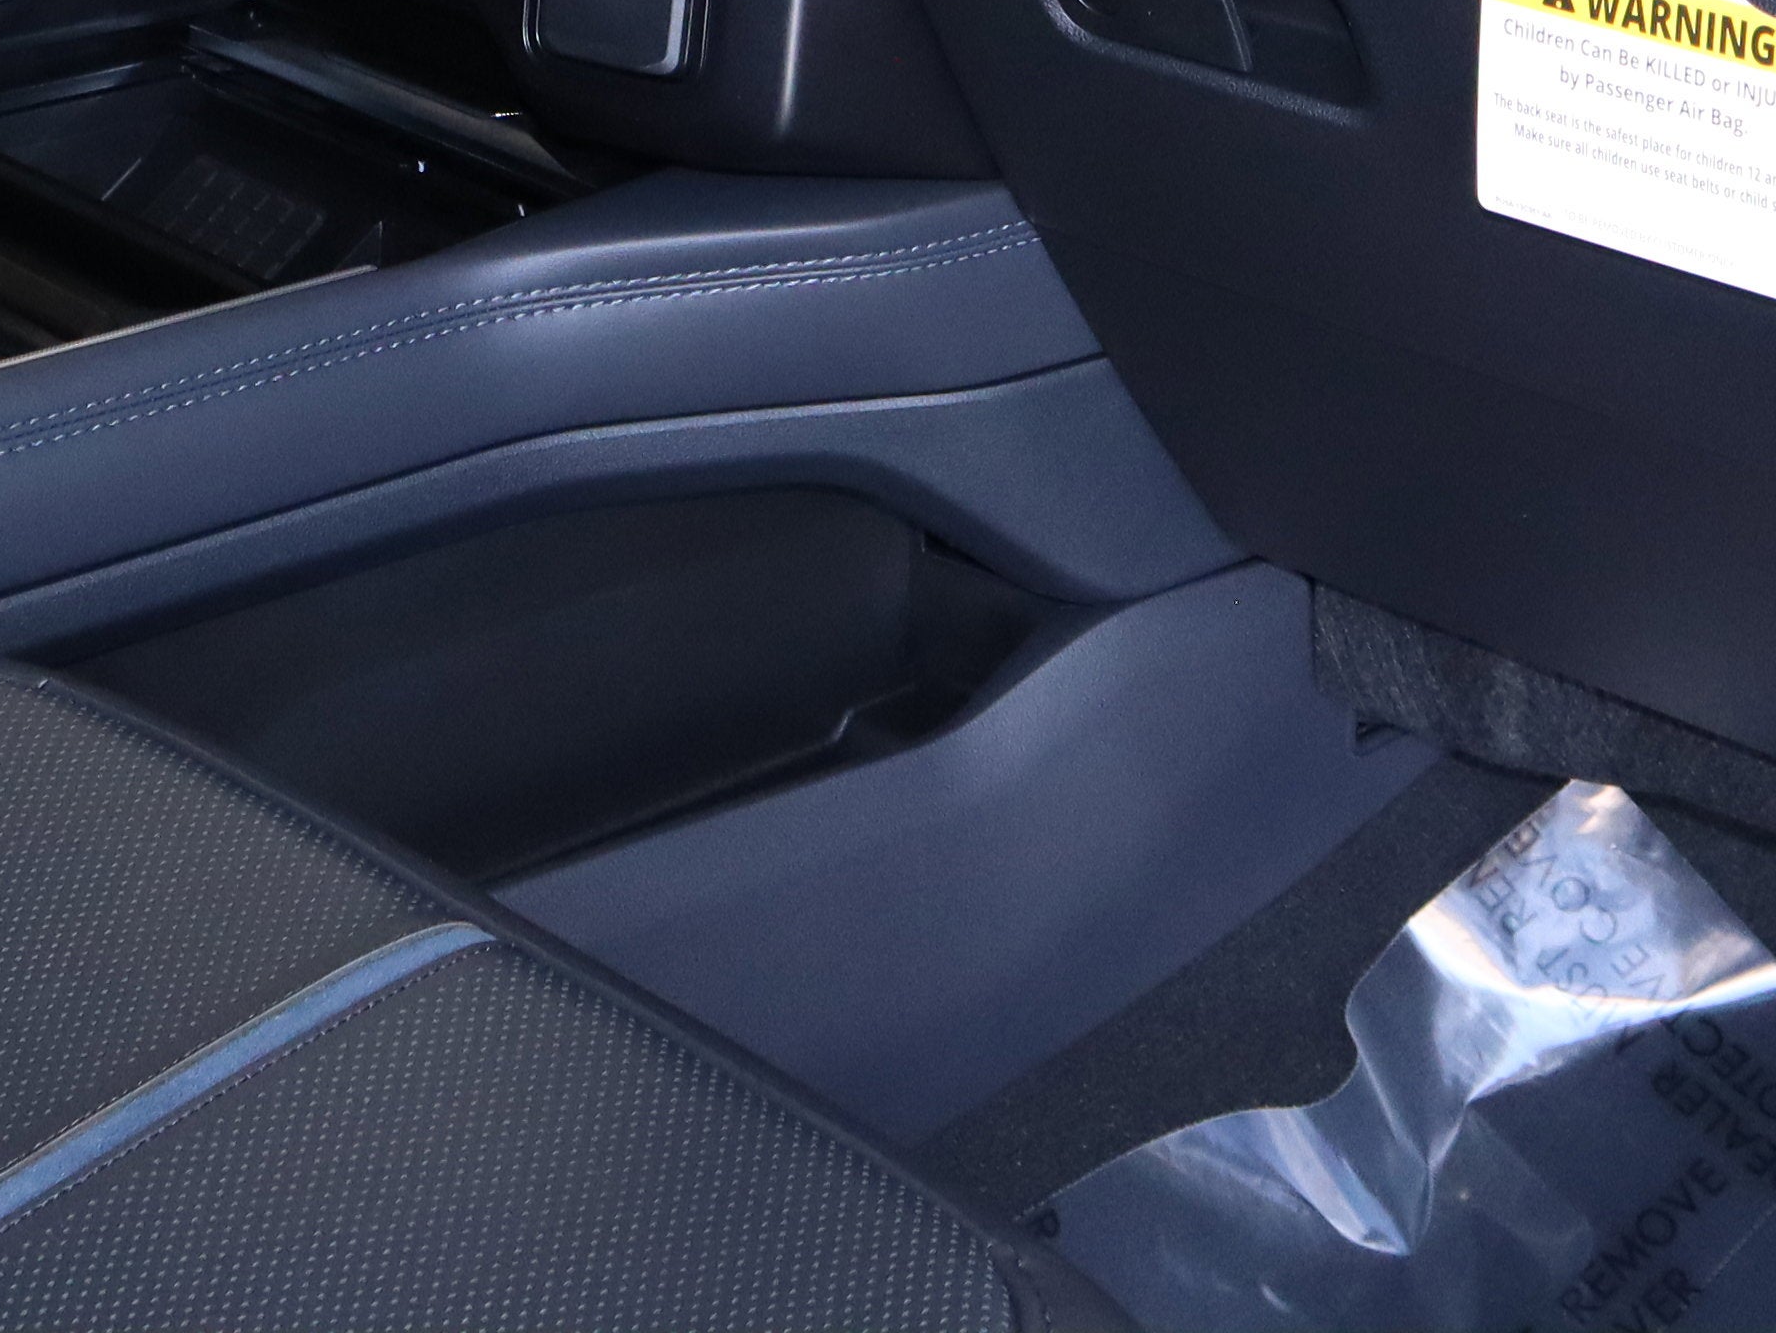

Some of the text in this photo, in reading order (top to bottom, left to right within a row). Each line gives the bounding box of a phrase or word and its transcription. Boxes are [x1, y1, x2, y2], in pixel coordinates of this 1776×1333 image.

[1504, 18, 1575, 52] Children
[1580, 39, 1612, 62] Can
[1618, 48, 1640, 69] Be
[1646, 55, 1706, 87] KILLED
[1712, 78, 1730, 95] or
[1494, 92, 1513, 111] The
[1516, 97, 1542, 118] back
[1545, 108, 1568, 126] seat
[1571, 114, 1580, 129] is
[1583, 119, 1602, 137] the
[1605, 126, 1639, 147] safest
[1642, 136, 1672, 156] place
[1676, 144, 1692, 162] for
[1696, 150, 1743, 177] children
[1748, 165, 1761, 182] 12
[1559, 65, 1748, 138] by Passenger Air Bag.
[1514, 122, 1545, 144] Make
[1548, 134, 1572, 152] sure
[1575, 141, 1588, 158] all
[1592, 146, 1637, 171] children
[1641, 161, 1660, 178] use
[1664, 167, 1688, 185] seat
[1692, 173, 1720, 196] belts
[1724, 185, 1736, 199] or
[1740, 188, 1768, 209] child
[1560, 1155, 1725, 1325] REMOVE
